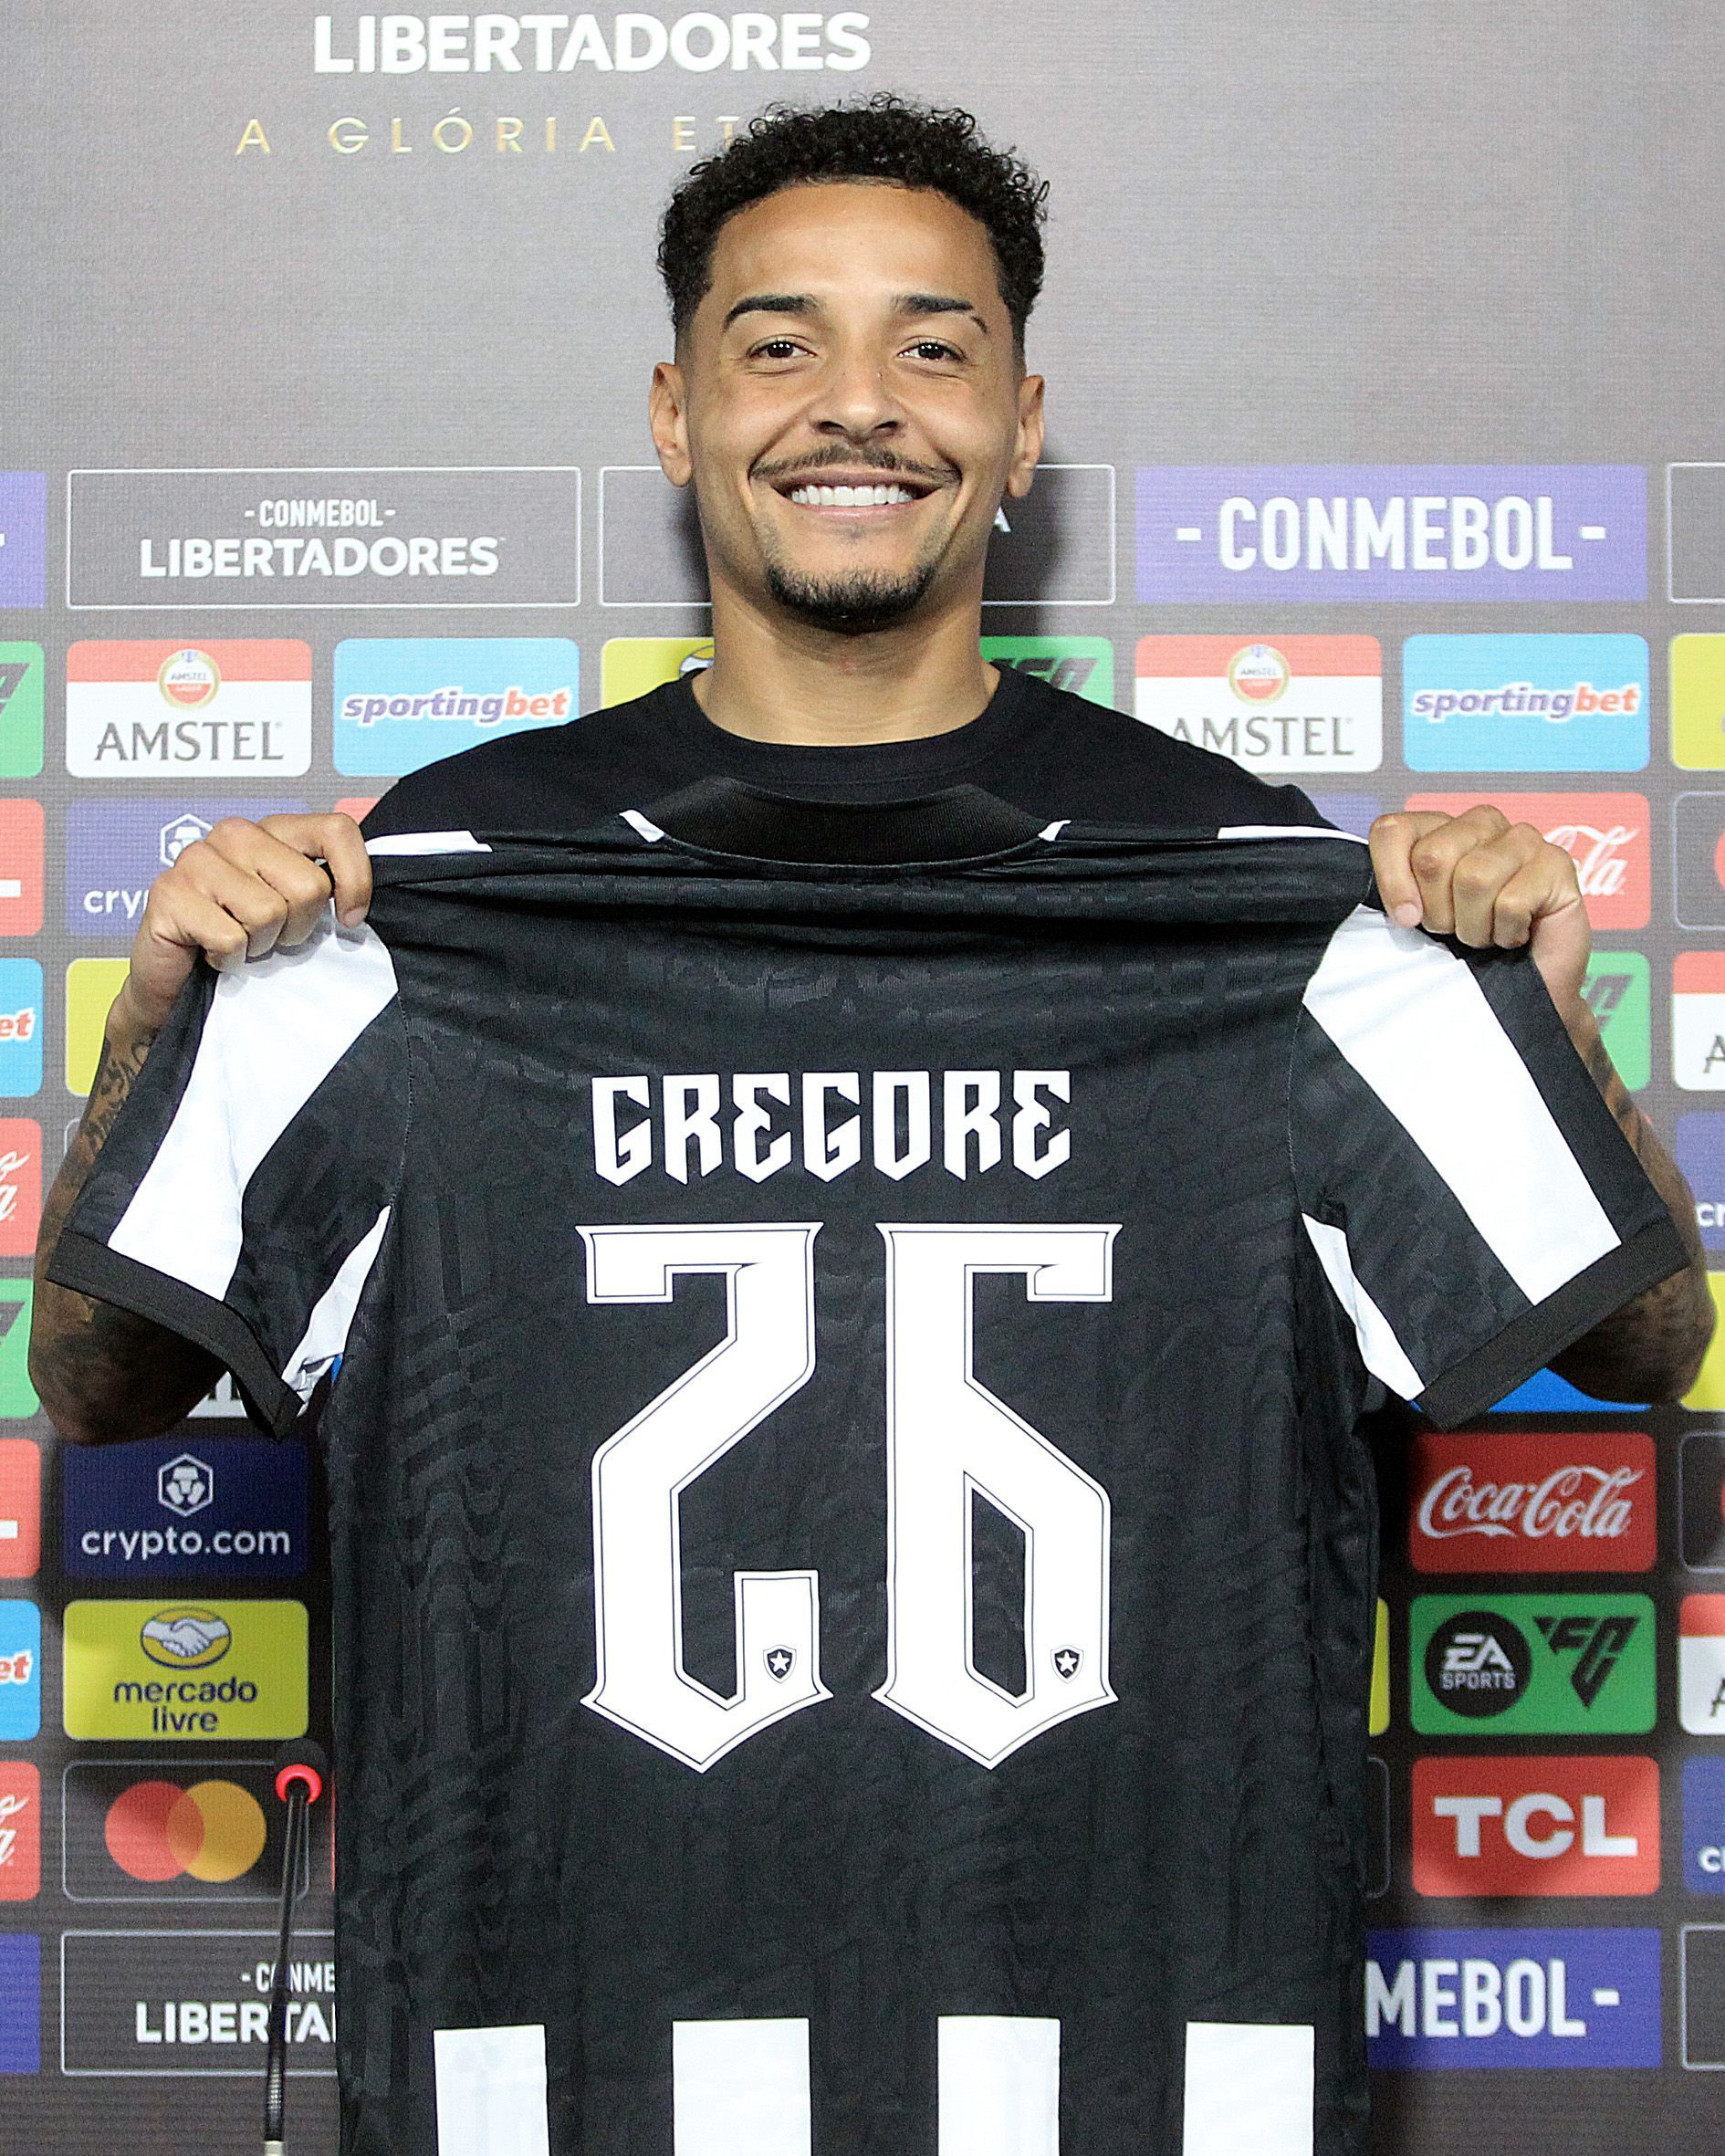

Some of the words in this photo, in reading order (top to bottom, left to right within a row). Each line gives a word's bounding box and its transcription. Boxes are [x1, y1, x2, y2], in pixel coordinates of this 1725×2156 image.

[315, 12, 871, 73] LIBERTADORES
[235, 120, 270, 156] A
[327, 107, 616, 154] GLÓRIA
[140, 537, 499, 577] LIBERTADORES
[343, 687, 570, 724] sportingbet
[1414, 683, 1640, 720] sportingbet
[94, 721, 284, 761] AMSTEL
[591, 1070, 1071, 1187] GREGORE
[575, 1221, 1123, 1773] 26
[1418, 1465, 1645, 1539] Coca-Cola
[80, 1526, 290, 1559] crypto.com
[1444, 1633, 1514, 1671] EA
[113, 1676, 258, 1702] mercado
[1441, 1671, 1516, 1690] SPORTS
[152, 1708, 218, 1733] livre
[1434, 1793, 1638, 1859] TCL
[136, 2002, 337, 2044] LIBERTA
